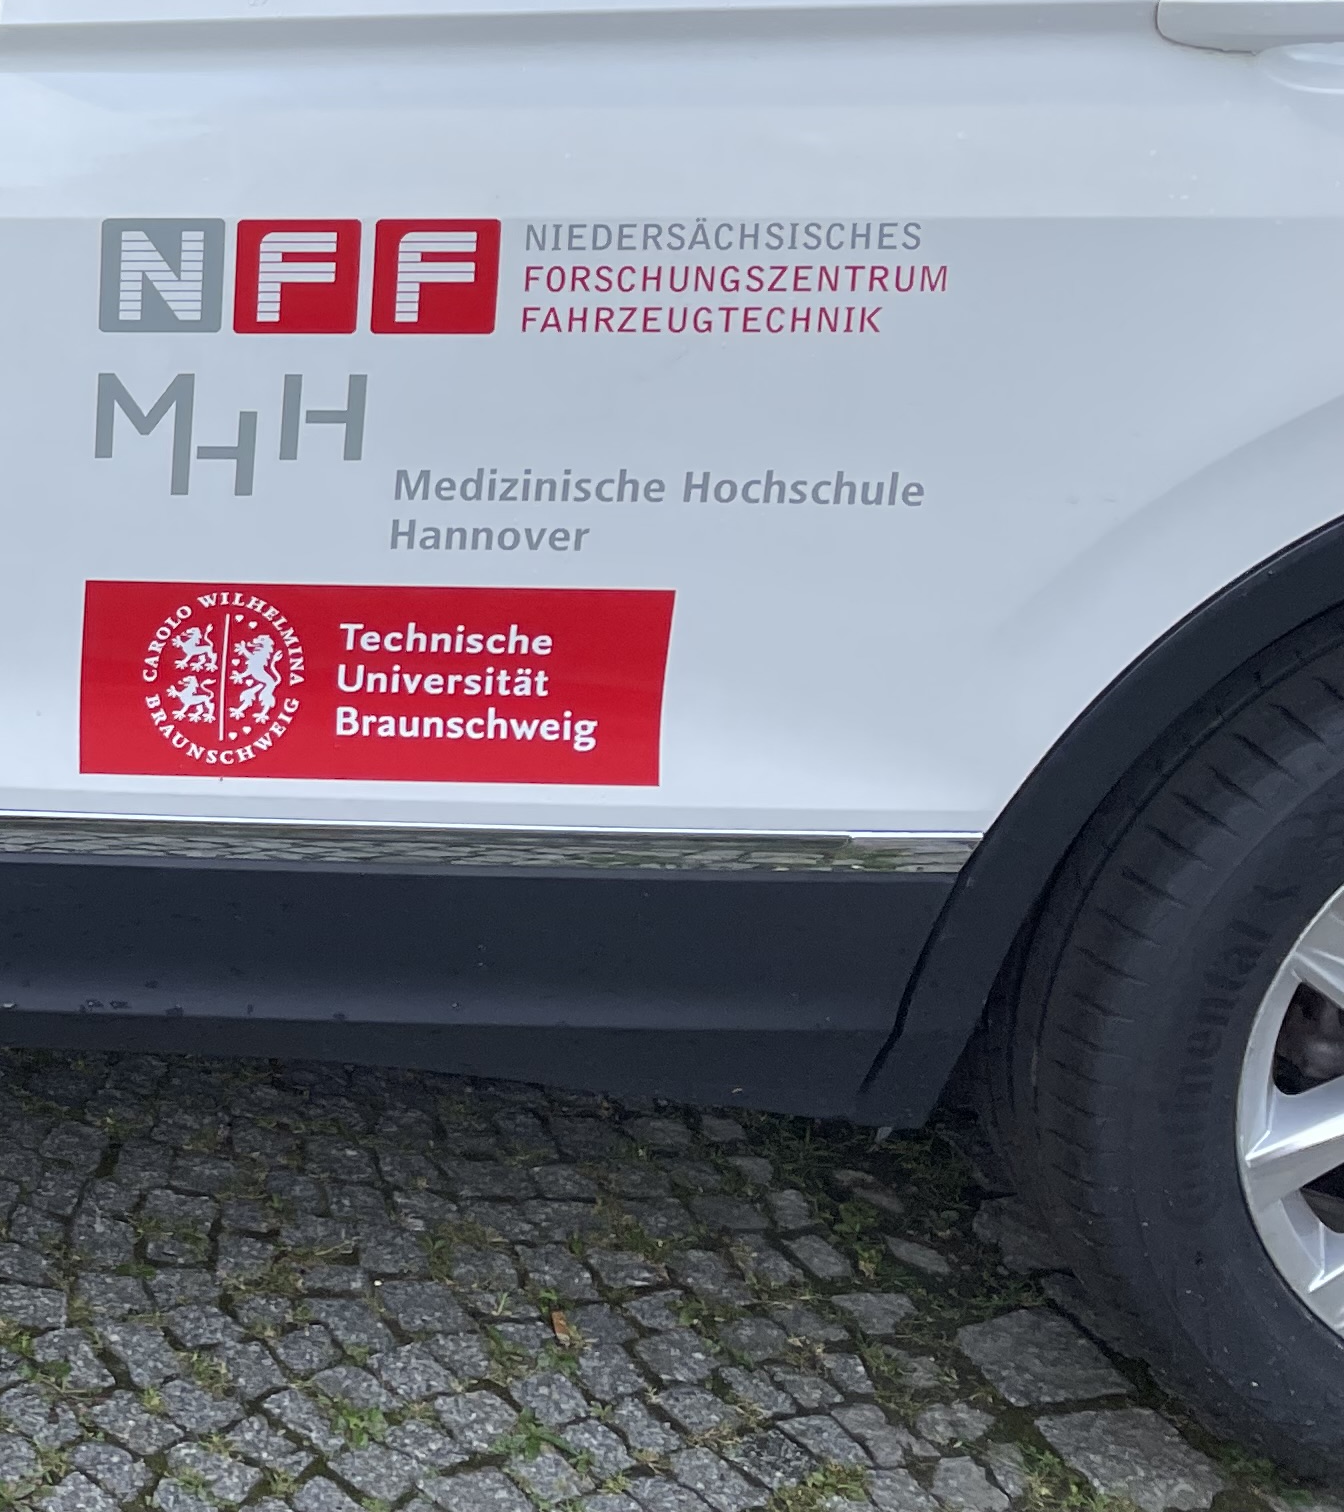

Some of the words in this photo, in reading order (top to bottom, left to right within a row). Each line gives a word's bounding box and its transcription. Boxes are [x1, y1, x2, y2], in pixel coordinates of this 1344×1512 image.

[525, 218, 922, 251] NIEDERSÄCHSISCHES
[119, 231, 477, 323] NFF
[524, 265, 948, 292] FORSCHUNGSZENTRUM
[521, 306, 883, 334] FAHRZEUGTECHNIK
[393, 468, 666, 503] Medizinische
[682, 470, 925, 506] Hochschule
[390, 519, 591, 552] Hannover
[142, 605, 192, 682] CAROLO
[197, 592, 304, 686] WILHELMINA
[339, 622, 553, 655] Technische
[337, 664, 549, 697] Universität
[145, 694, 300, 765] BRAUNSCHWEIG
[336, 706, 598, 752] Braunschweig
